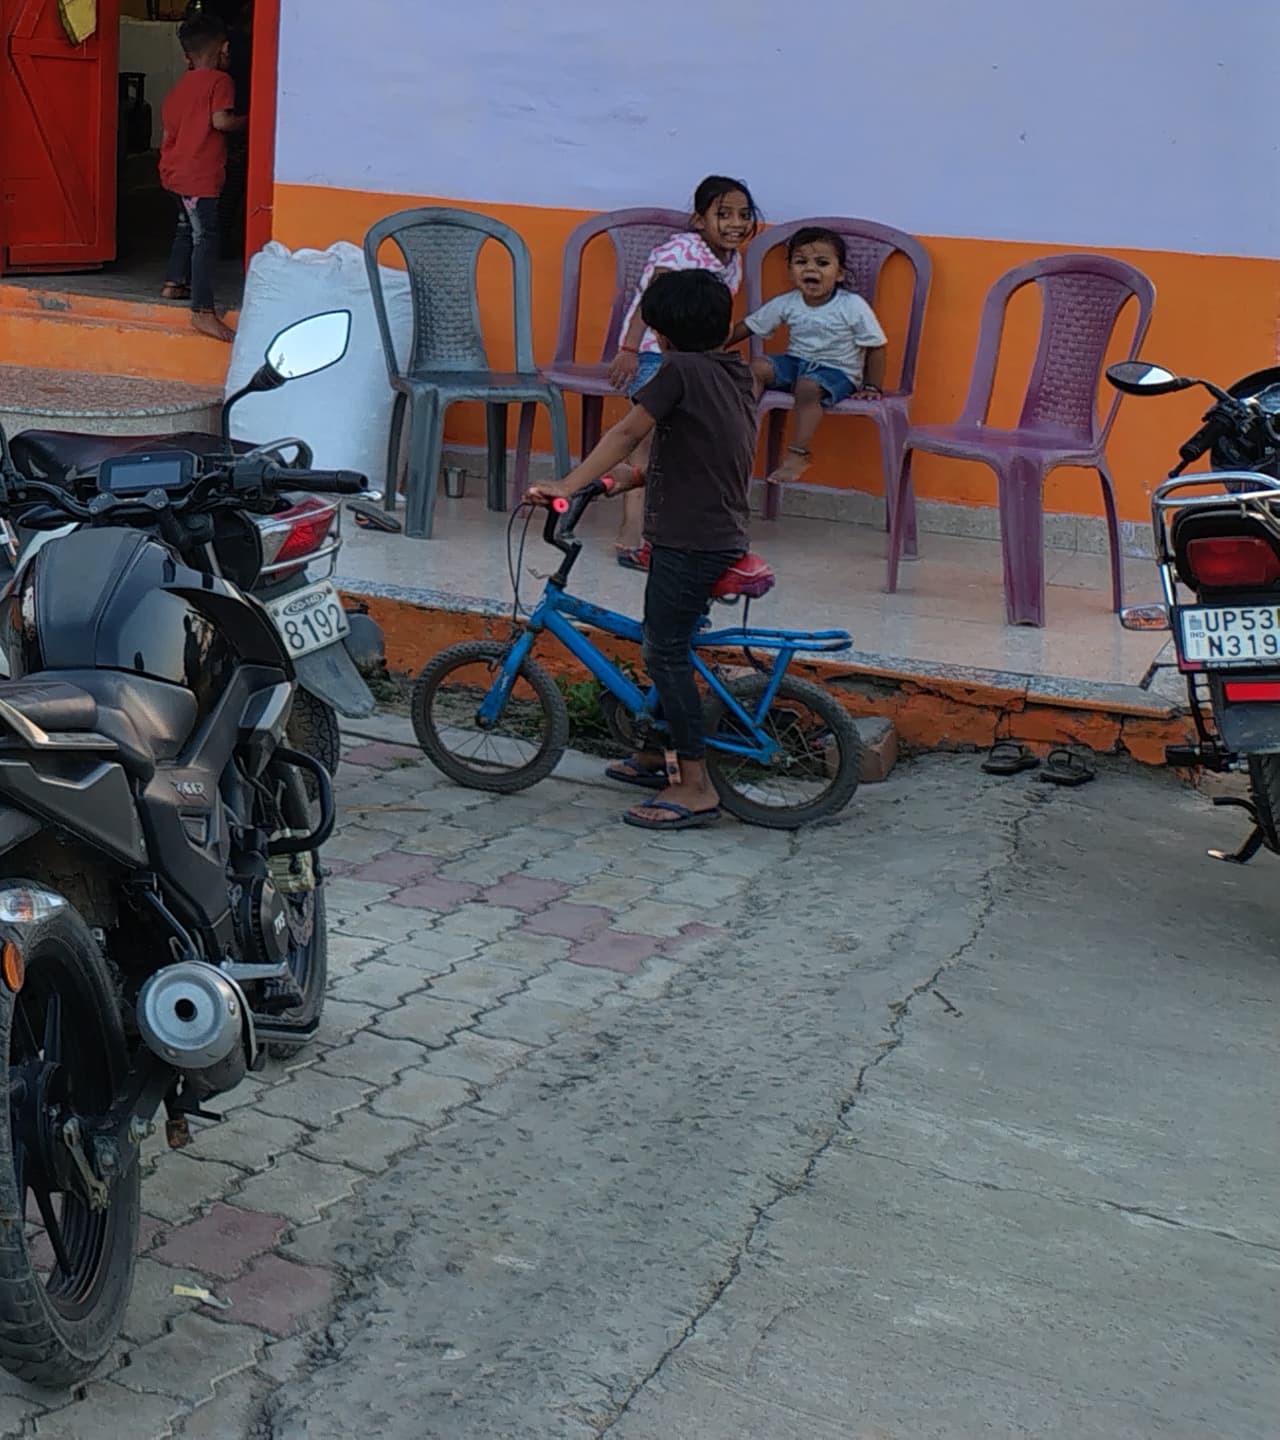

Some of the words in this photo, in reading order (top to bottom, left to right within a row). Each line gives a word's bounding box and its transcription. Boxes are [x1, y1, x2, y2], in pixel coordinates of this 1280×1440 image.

[284, 603, 346, 649] 8192
[1205, 609, 1274, 632] UP53
[1208, 634, 1278, 657] N319
